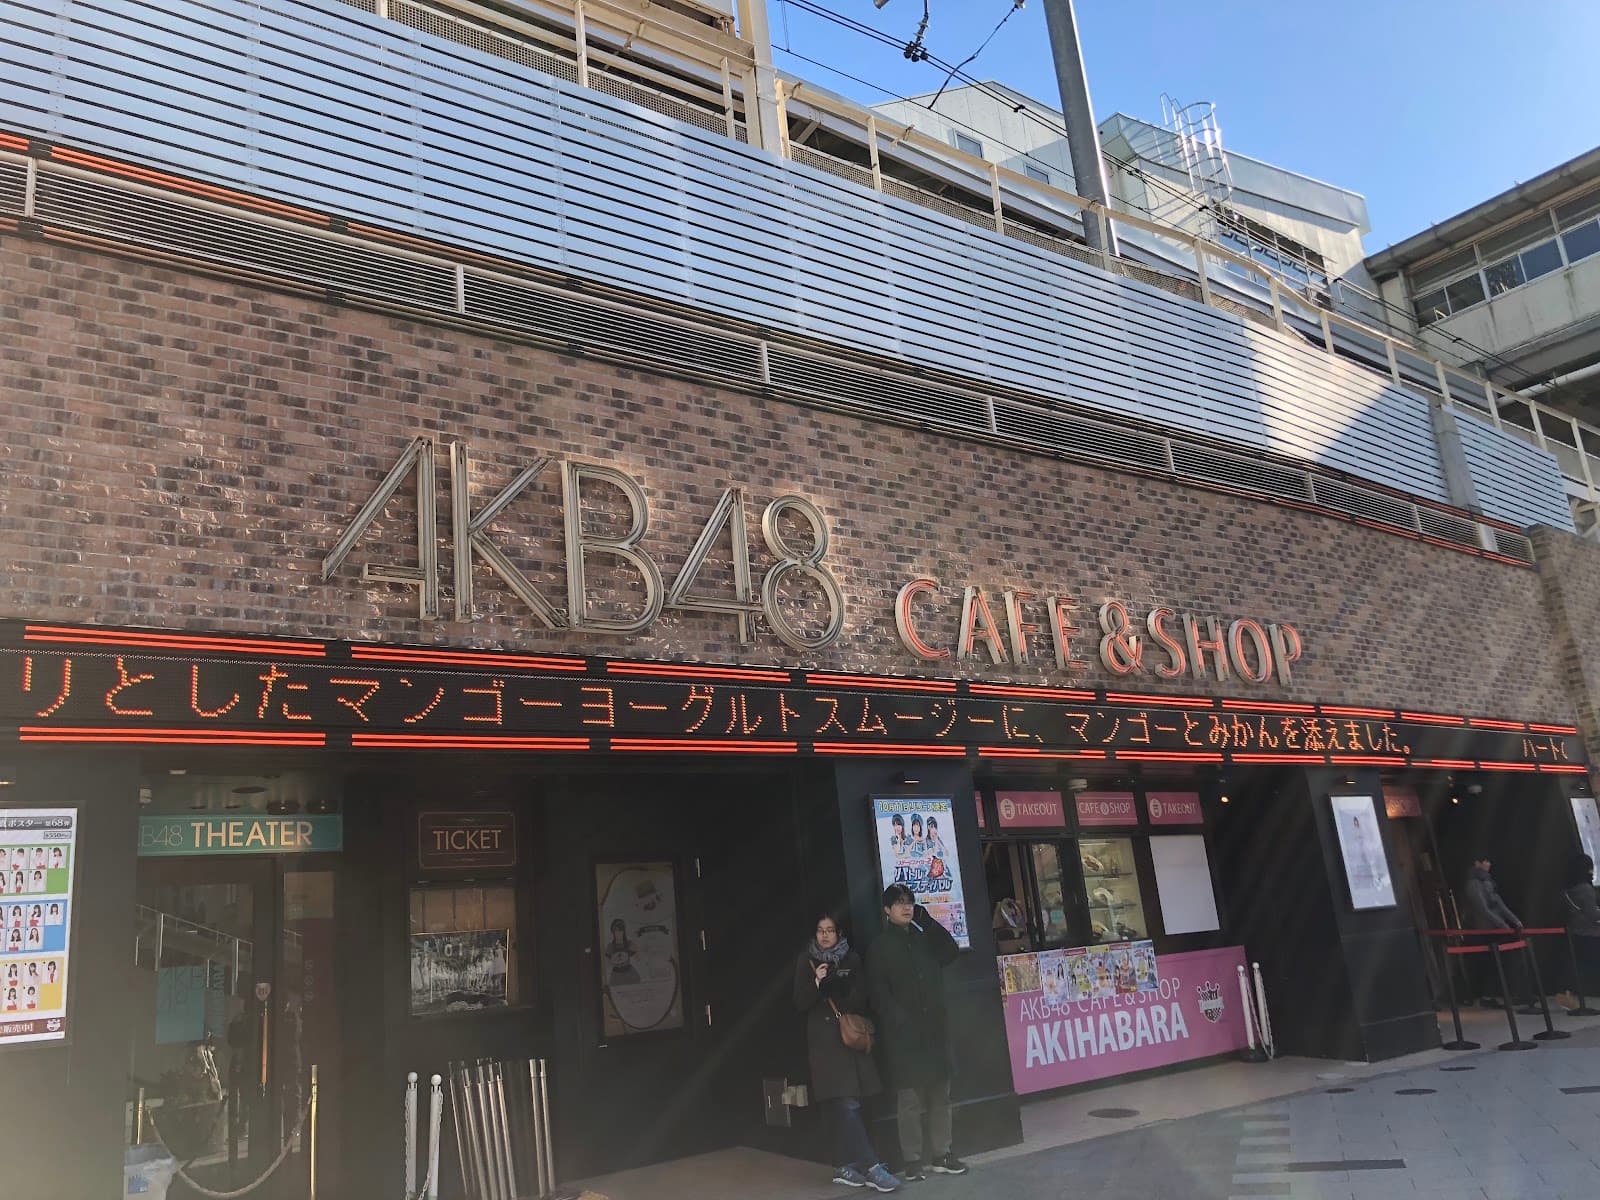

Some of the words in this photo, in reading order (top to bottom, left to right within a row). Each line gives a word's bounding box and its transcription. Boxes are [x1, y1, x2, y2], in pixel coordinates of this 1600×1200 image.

[322, 435, 846, 651] AKB48
[1015, 803, 1057, 816] TAKEOUT
[1162, 801, 1197, 815] TAKEOUT
[138, 823, 183, 848] B48
[191, 821, 313, 848] THEATER
[433, 829, 502, 850] TICKET
[1026, 1001, 1190, 1069] AKIHABARA
